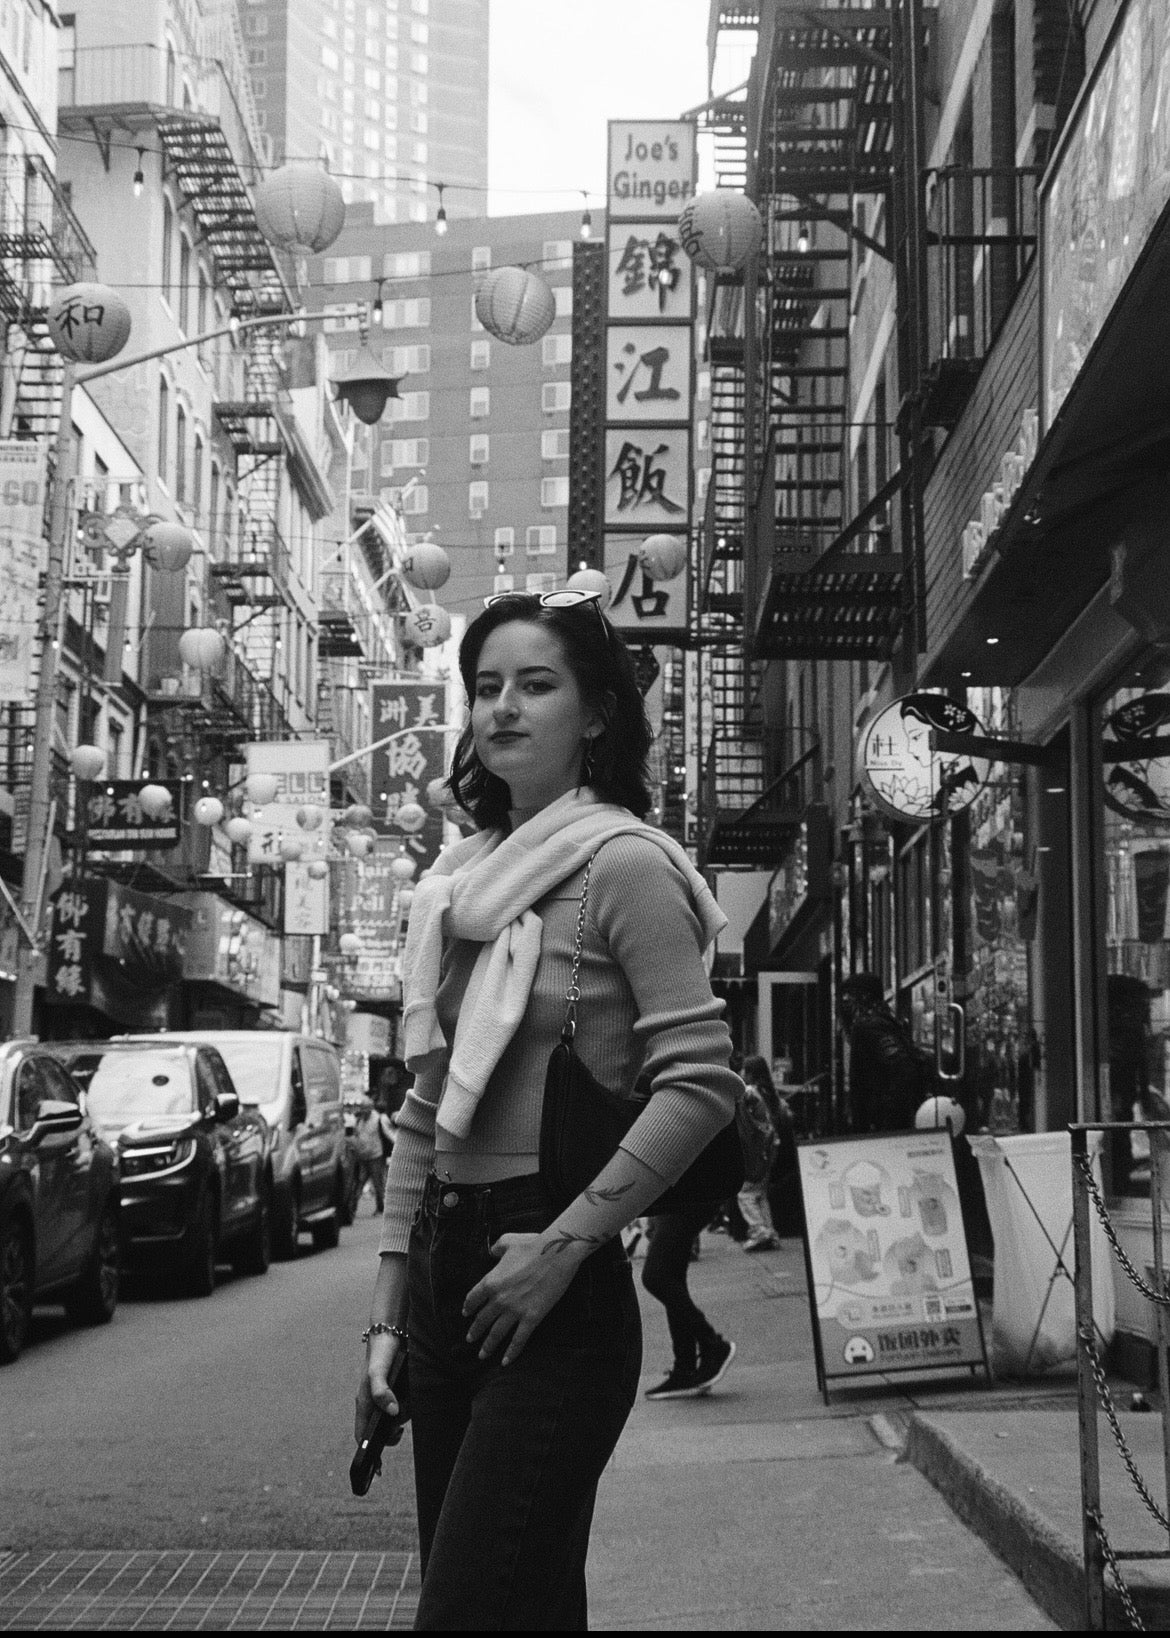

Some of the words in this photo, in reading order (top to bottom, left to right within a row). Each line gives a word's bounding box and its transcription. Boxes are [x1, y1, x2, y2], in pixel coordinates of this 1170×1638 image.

[624, 133, 678, 161] Joe's
[613, 171, 690, 206] Ginger
[55, 296, 105, 340] 和
[605, 232, 686, 620] 錦江飯店
